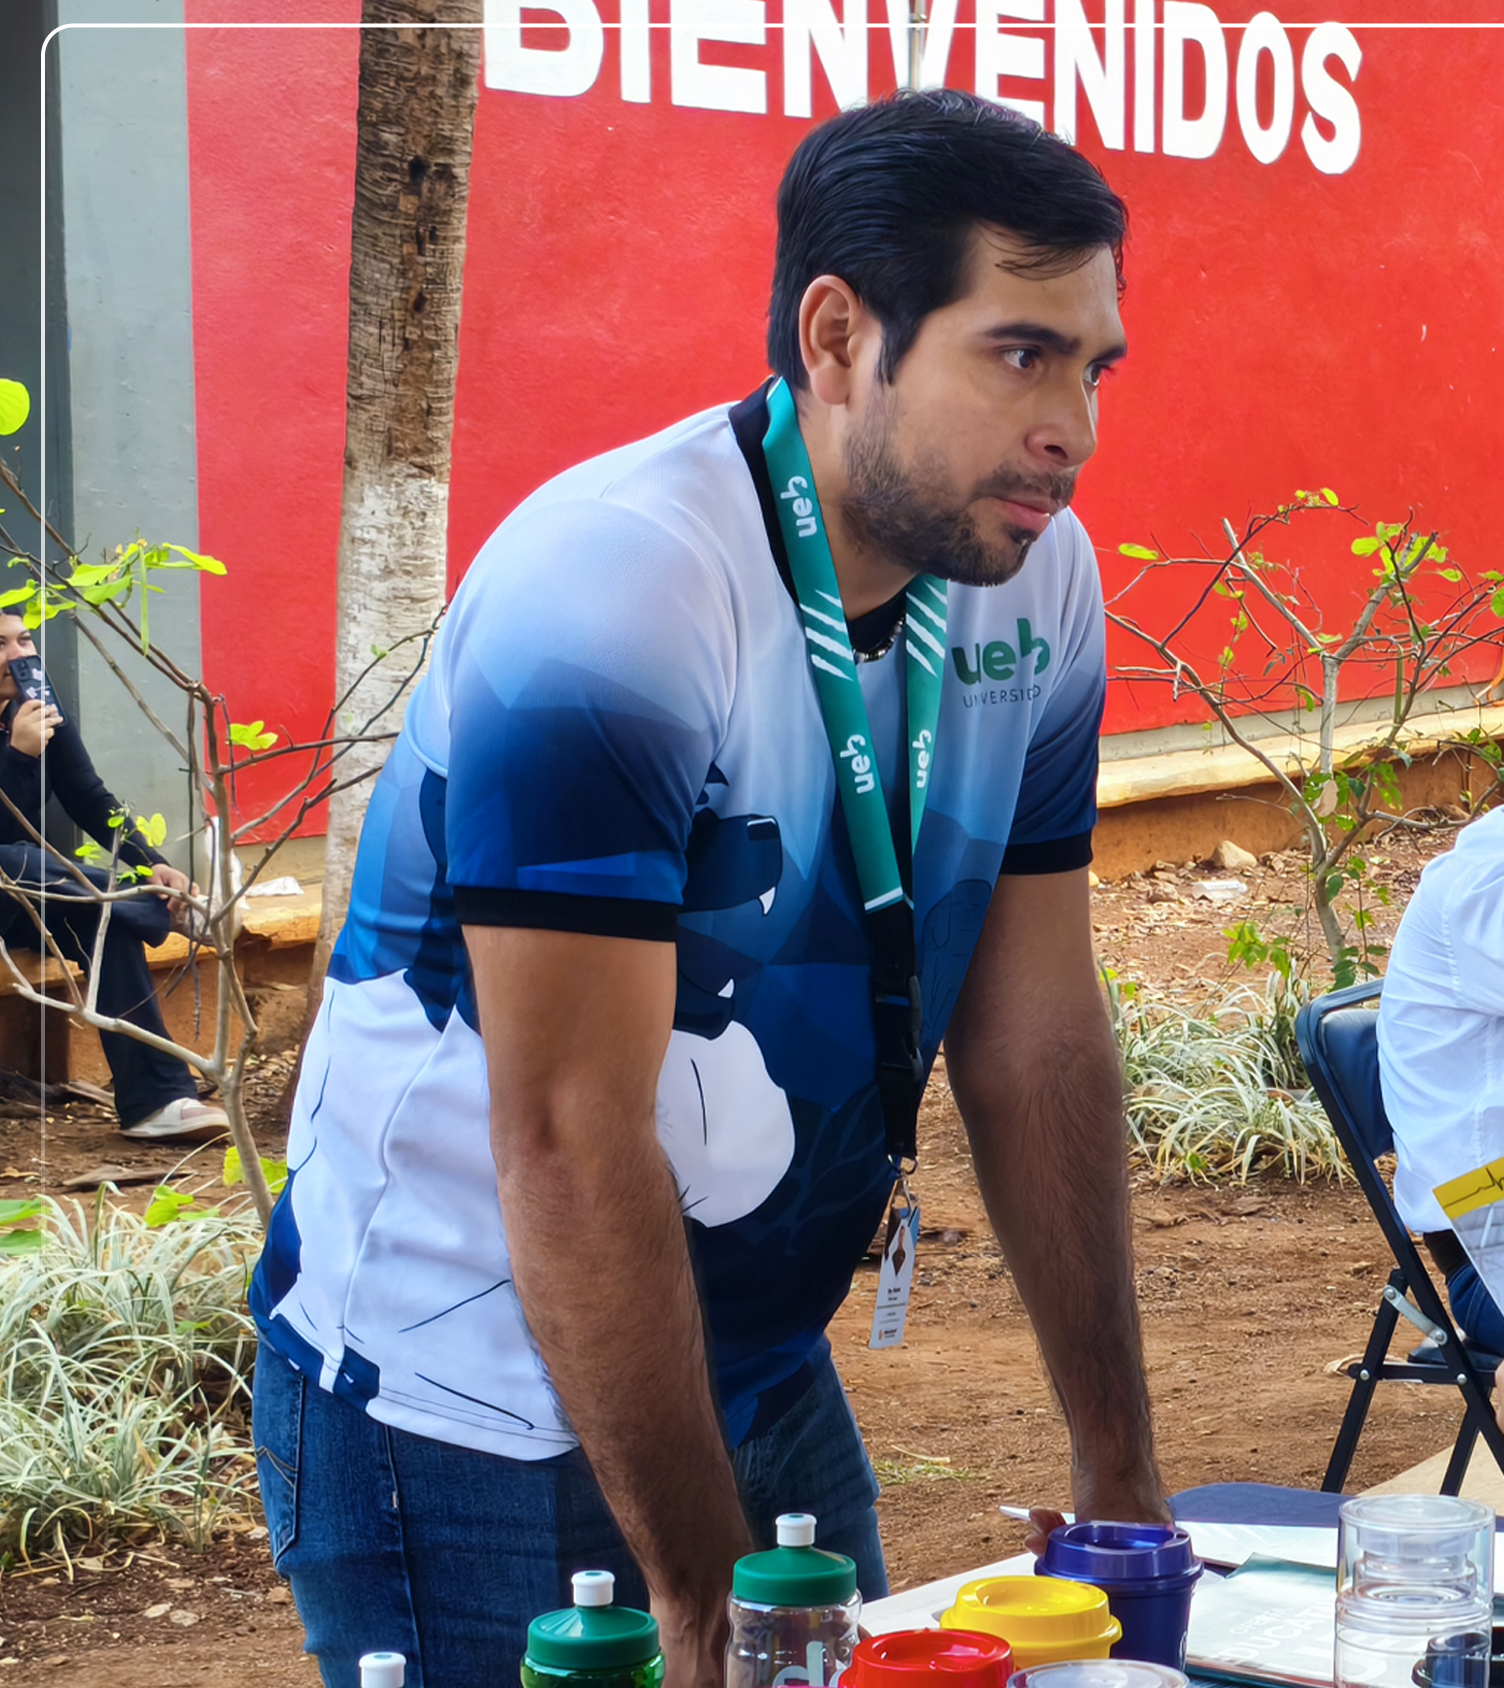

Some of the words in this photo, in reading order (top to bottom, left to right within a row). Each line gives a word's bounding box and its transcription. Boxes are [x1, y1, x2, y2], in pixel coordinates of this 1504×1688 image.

[484, 0, 1363, 176] BIENVENIDOS
[780, 476, 818, 538] ueb
[951, 618, 1050, 686] ueb
[840, 734, 875, 794] ueb
[913, 729, 933, 788] ueb
